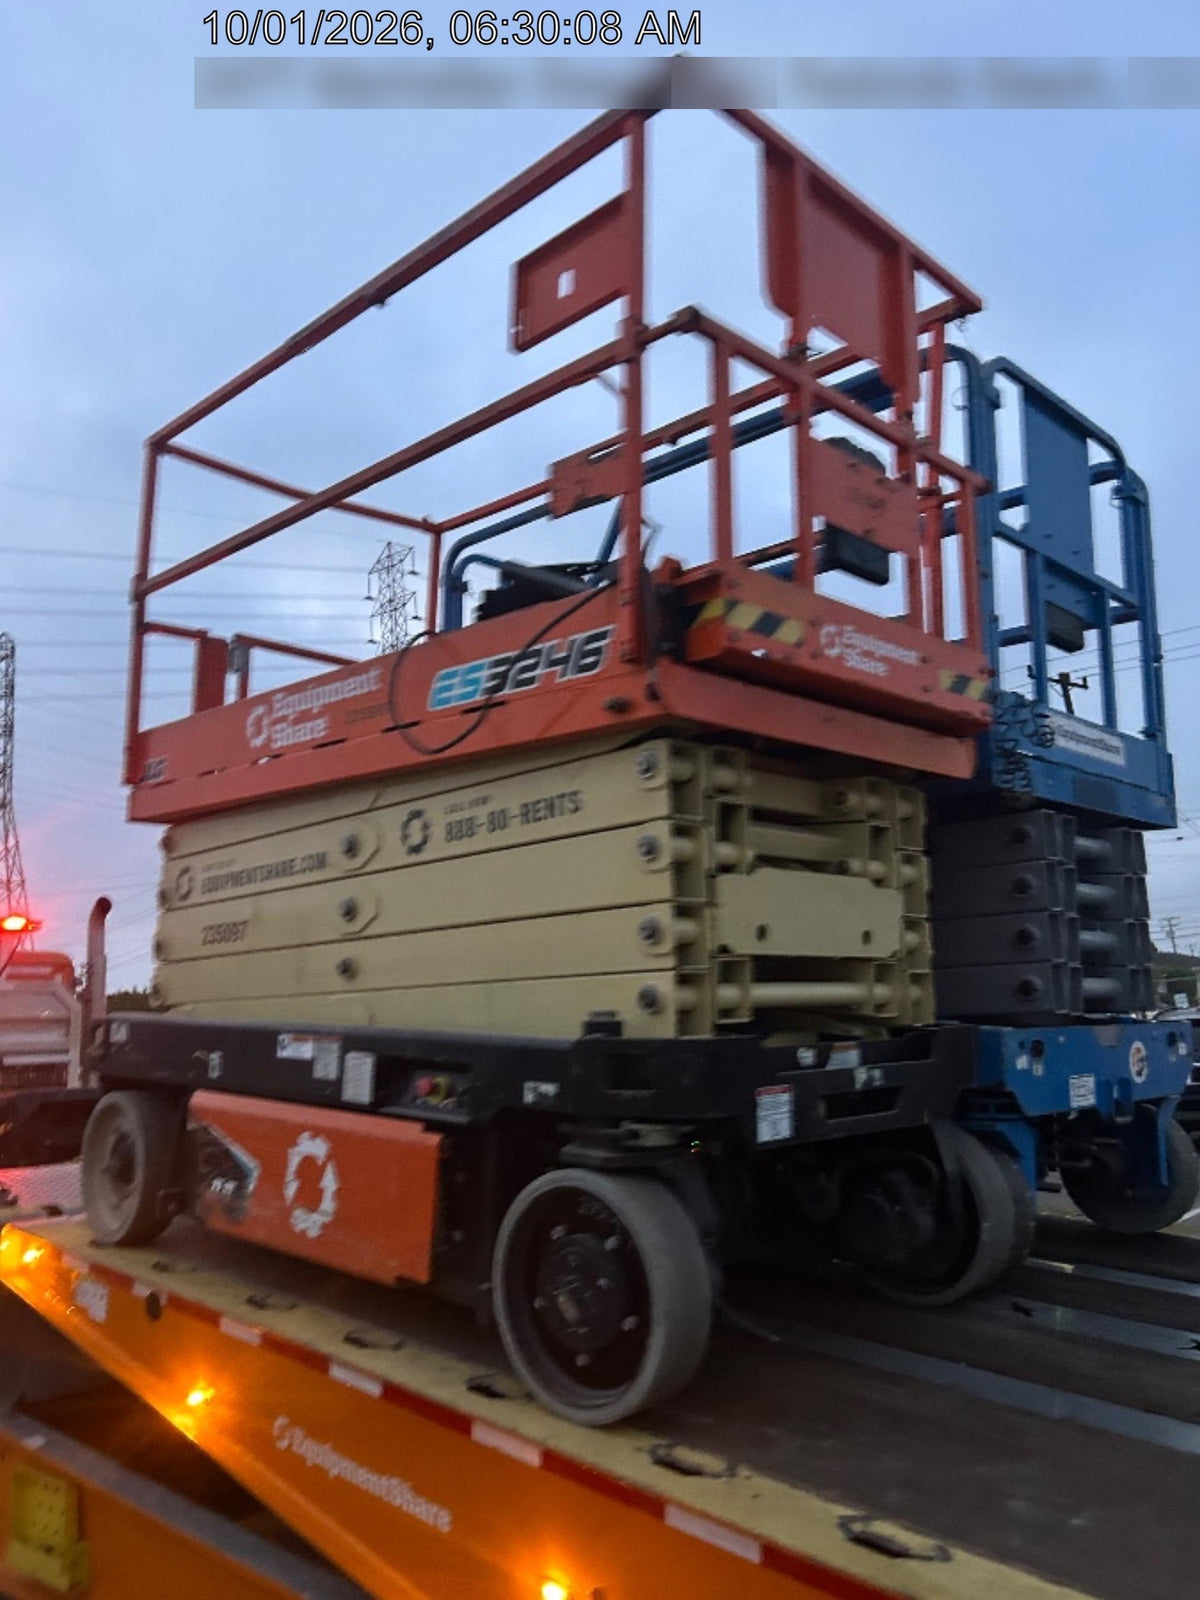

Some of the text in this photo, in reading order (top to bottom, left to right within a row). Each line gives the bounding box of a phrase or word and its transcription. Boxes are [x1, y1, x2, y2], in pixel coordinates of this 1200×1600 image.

[271, 667, 383, 719] Equipment
[427, 624, 617, 711] ES3246
[271, 715, 331, 749] Share
[444, 789, 582, 843] 888-80-RENTS
[201, 852, 328, 895] EQUIPMENTSHARE.COM
